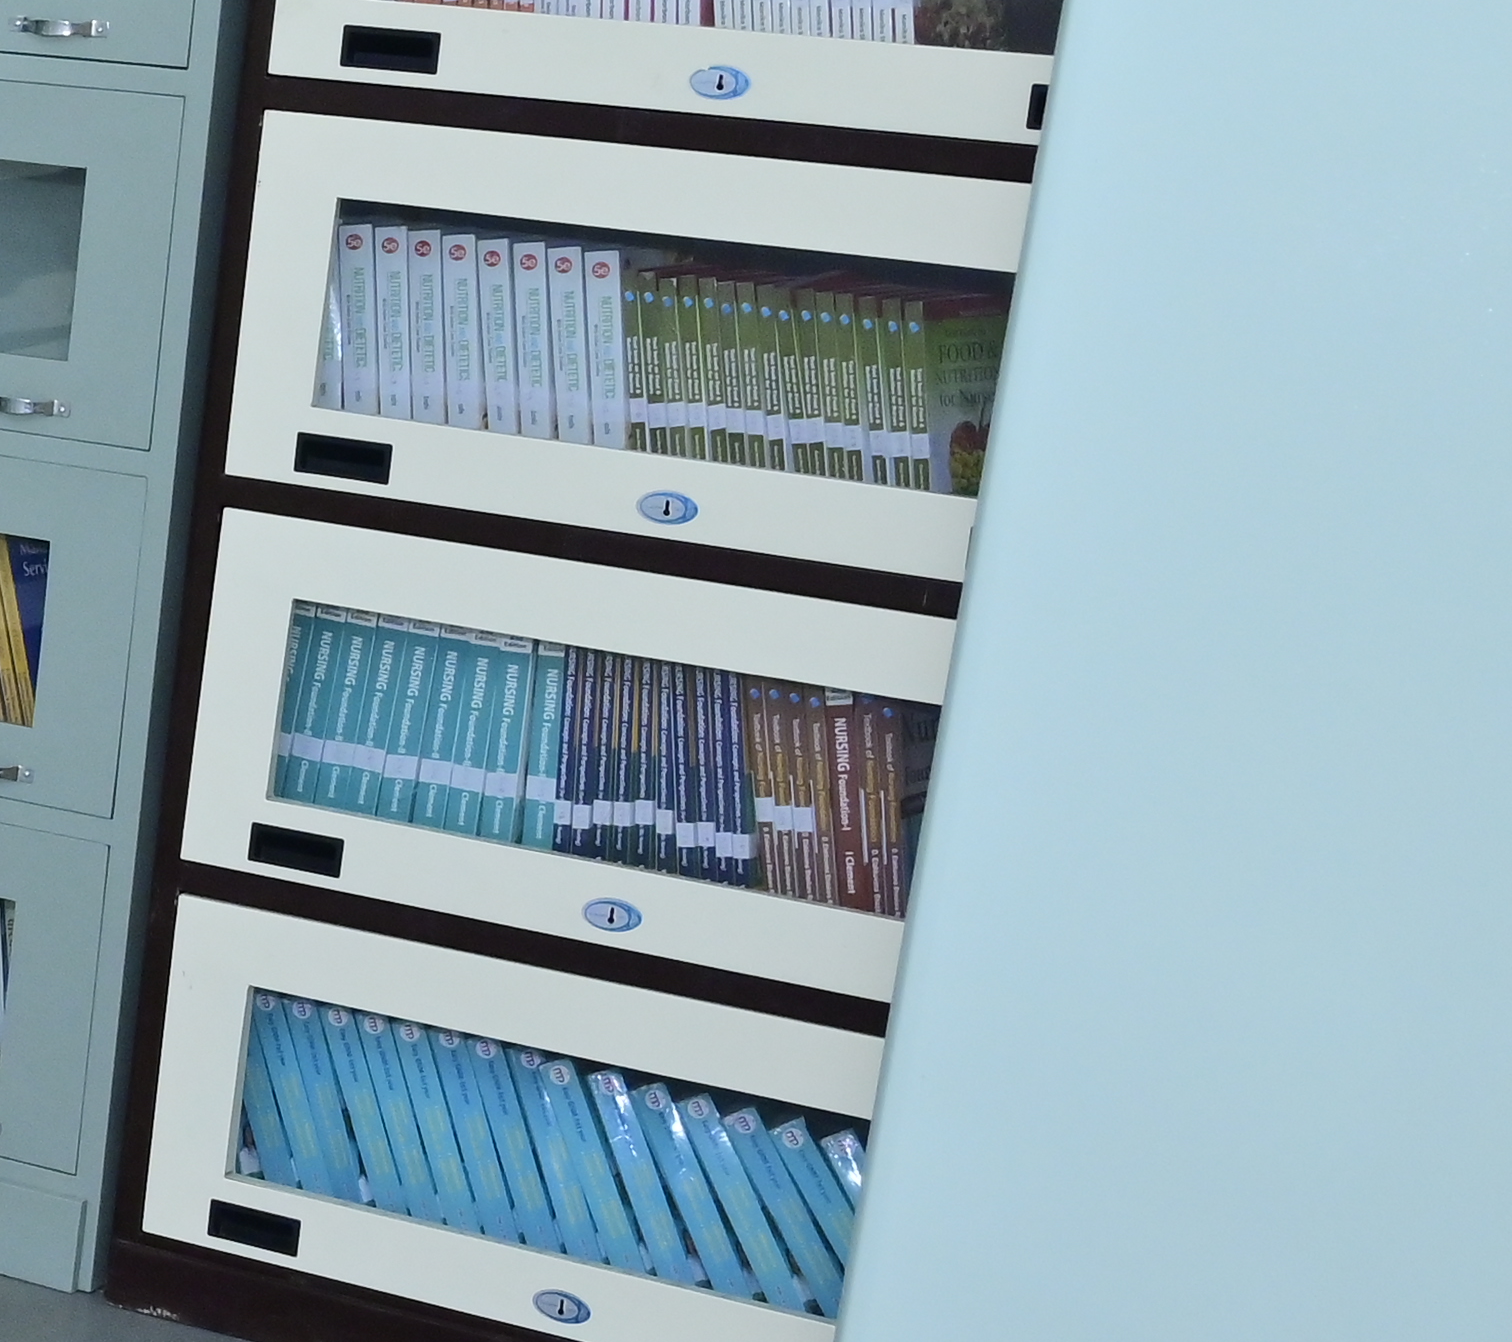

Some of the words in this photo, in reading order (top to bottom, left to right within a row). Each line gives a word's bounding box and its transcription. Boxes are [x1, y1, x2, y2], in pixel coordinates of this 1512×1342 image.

[455, 278, 469, 326] NUTRITION
[601, 296, 614, 344] NUTRITION
[471, 657, 489, 708] NURSING
[502, 664, 519, 716] NURSING
[543, 668, 559, 720] NURSING
[863, 714, 874, 746] Textbook
[492, 800, 503, 834] Clement
[535, 805, 546, 839] Clement
[833, 718, 850, 772] NURSING
[845, 857, 856, 894] Clement
